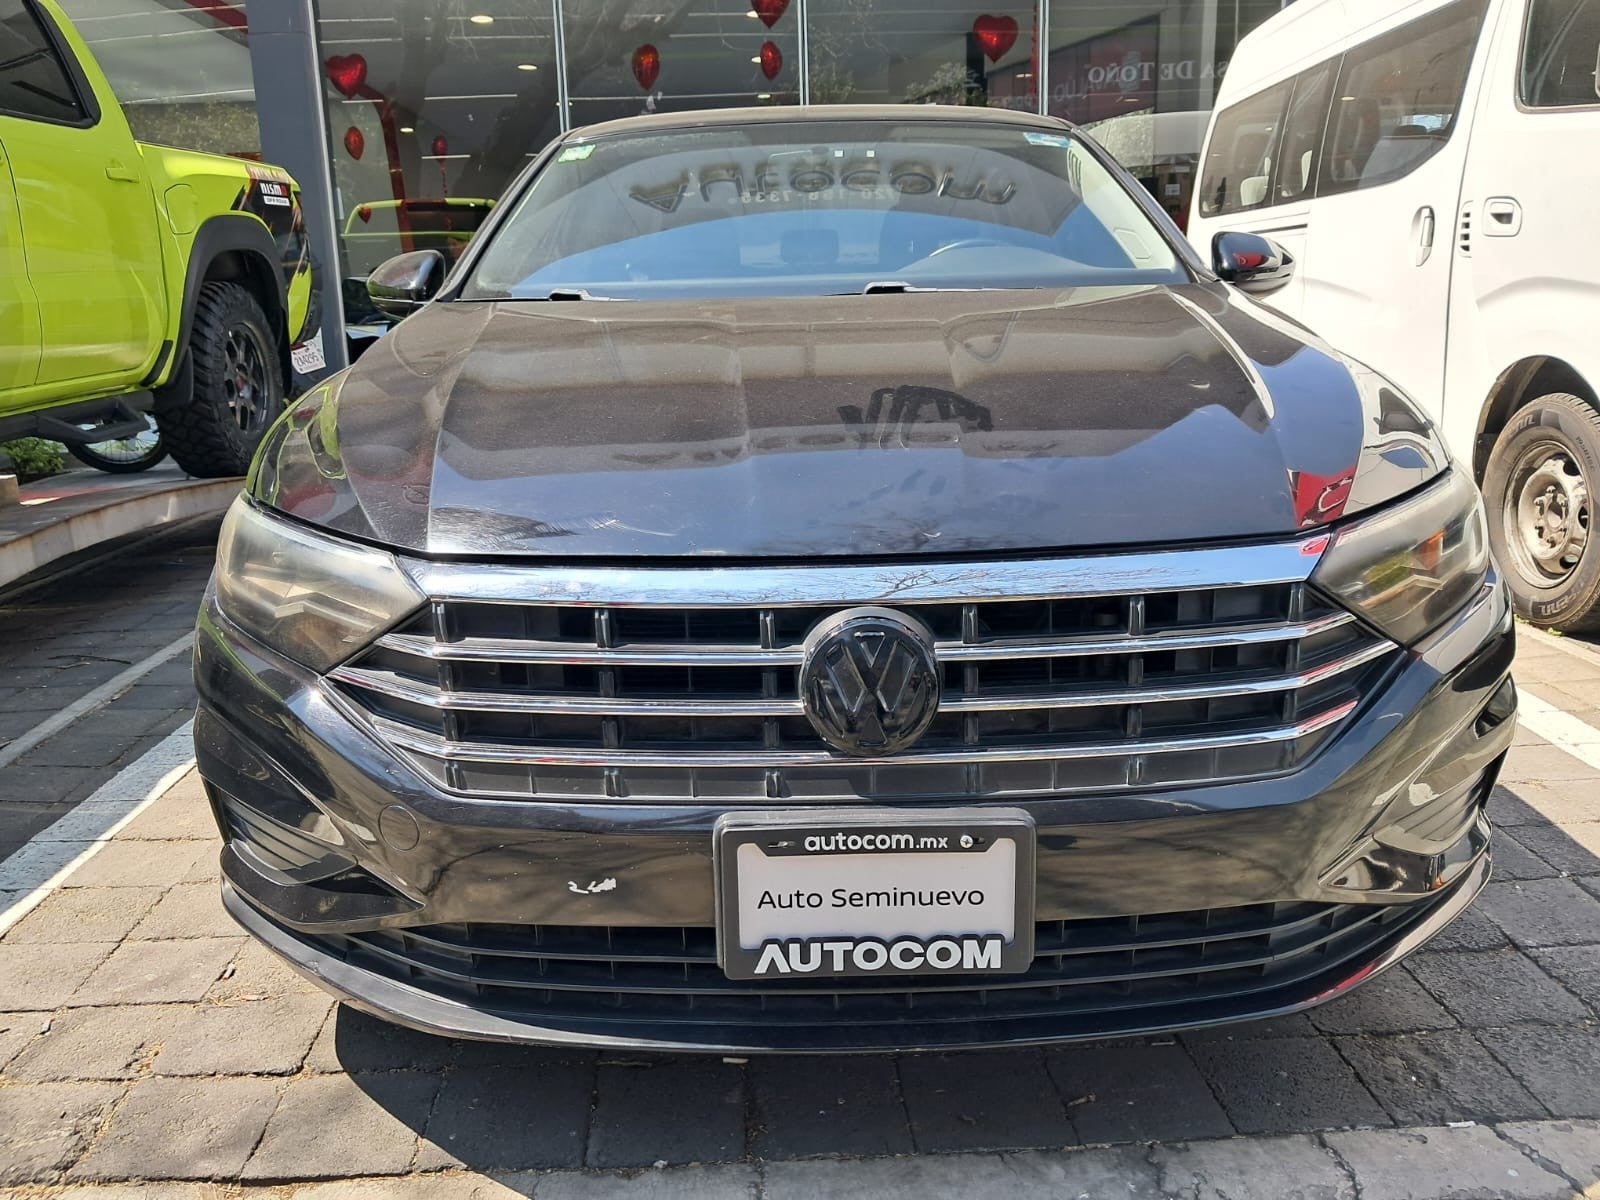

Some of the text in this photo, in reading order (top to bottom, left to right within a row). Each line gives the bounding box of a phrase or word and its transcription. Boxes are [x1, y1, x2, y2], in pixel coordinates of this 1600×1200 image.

[804, 832, 949, 852] autocom.mx
[757, 887, 985, 909] Auto Seminuevo
[754, 939, 1002, 974] AUTOCOM
